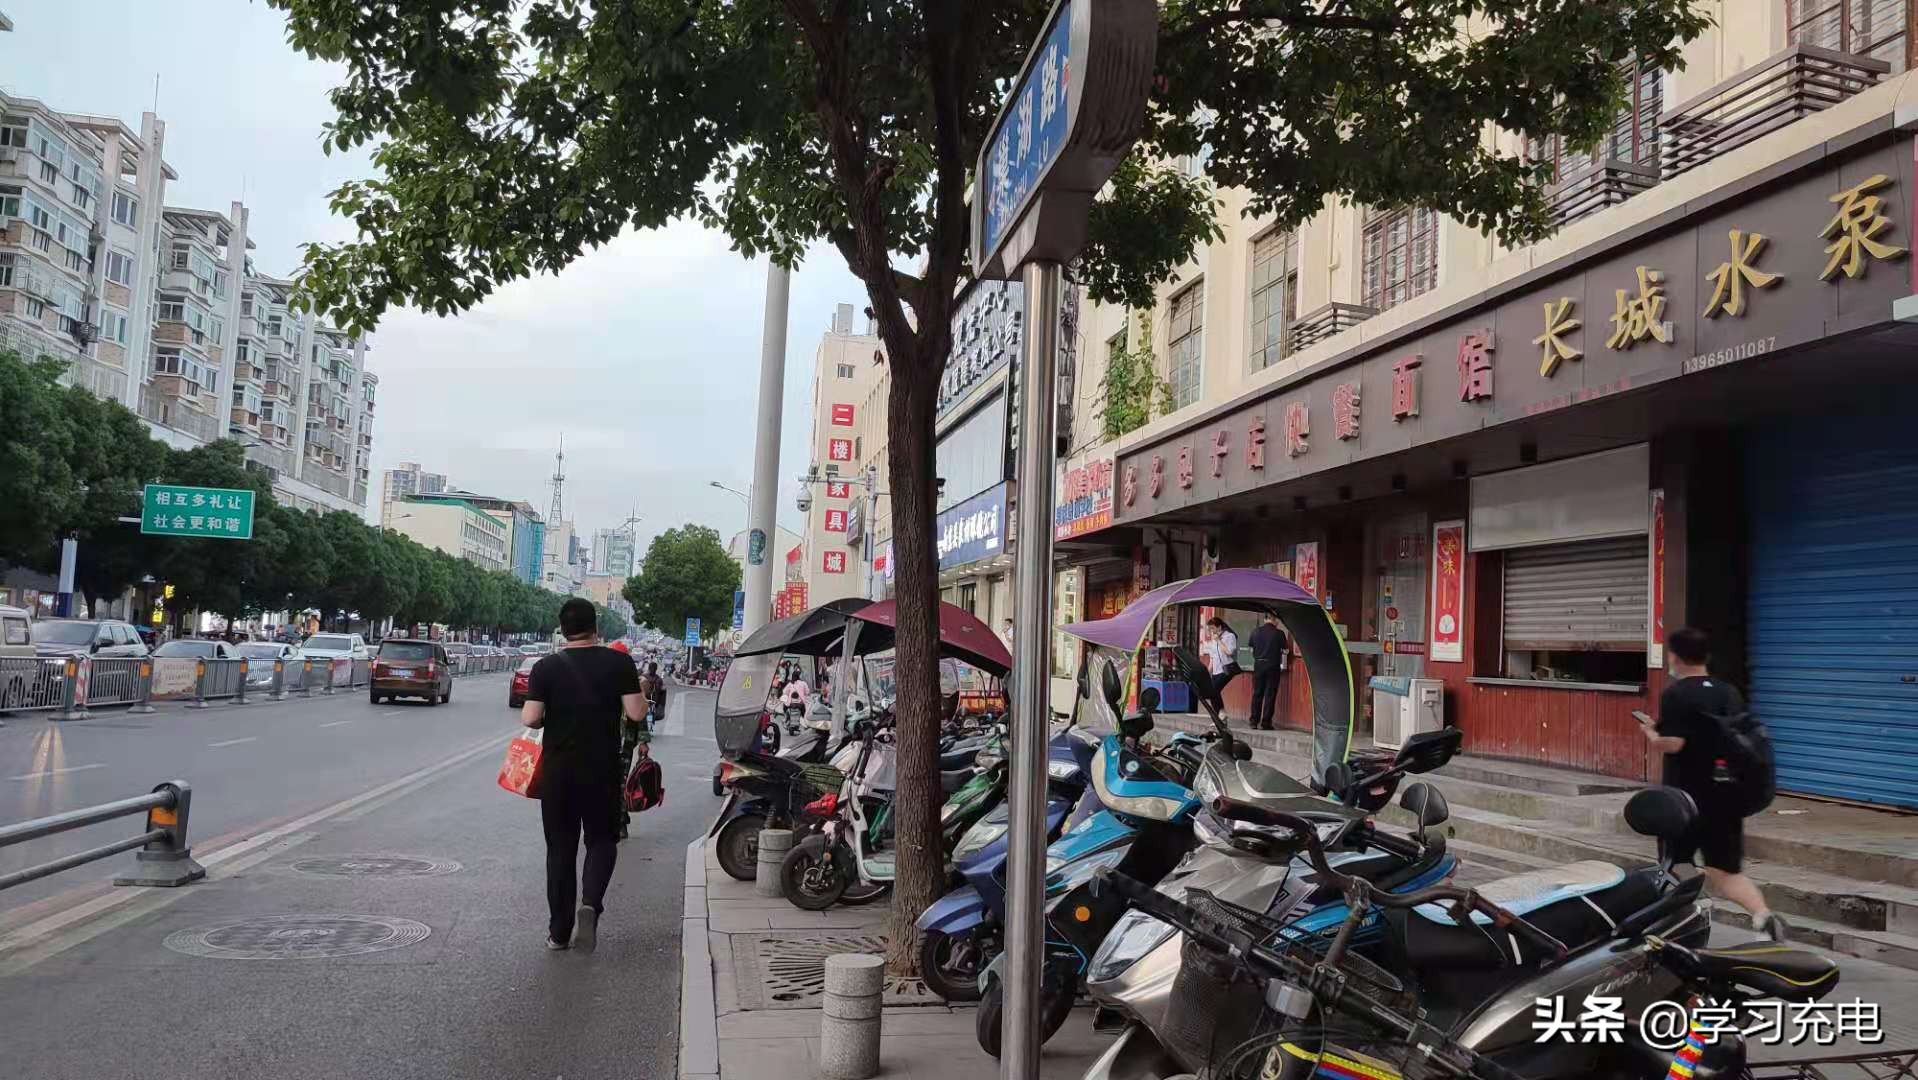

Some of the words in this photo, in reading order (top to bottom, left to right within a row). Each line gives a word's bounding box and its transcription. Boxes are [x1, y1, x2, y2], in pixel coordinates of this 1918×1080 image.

[1532, 174, 1909, 377] 长城水泵
[1684, 336, 1776, 373] 13965011087
[155, 491, 242, 510] 相互多礼让
[826, 407, 850, 572] 二楼家具城
[153, 513, 241, 532] 社会更和谐
